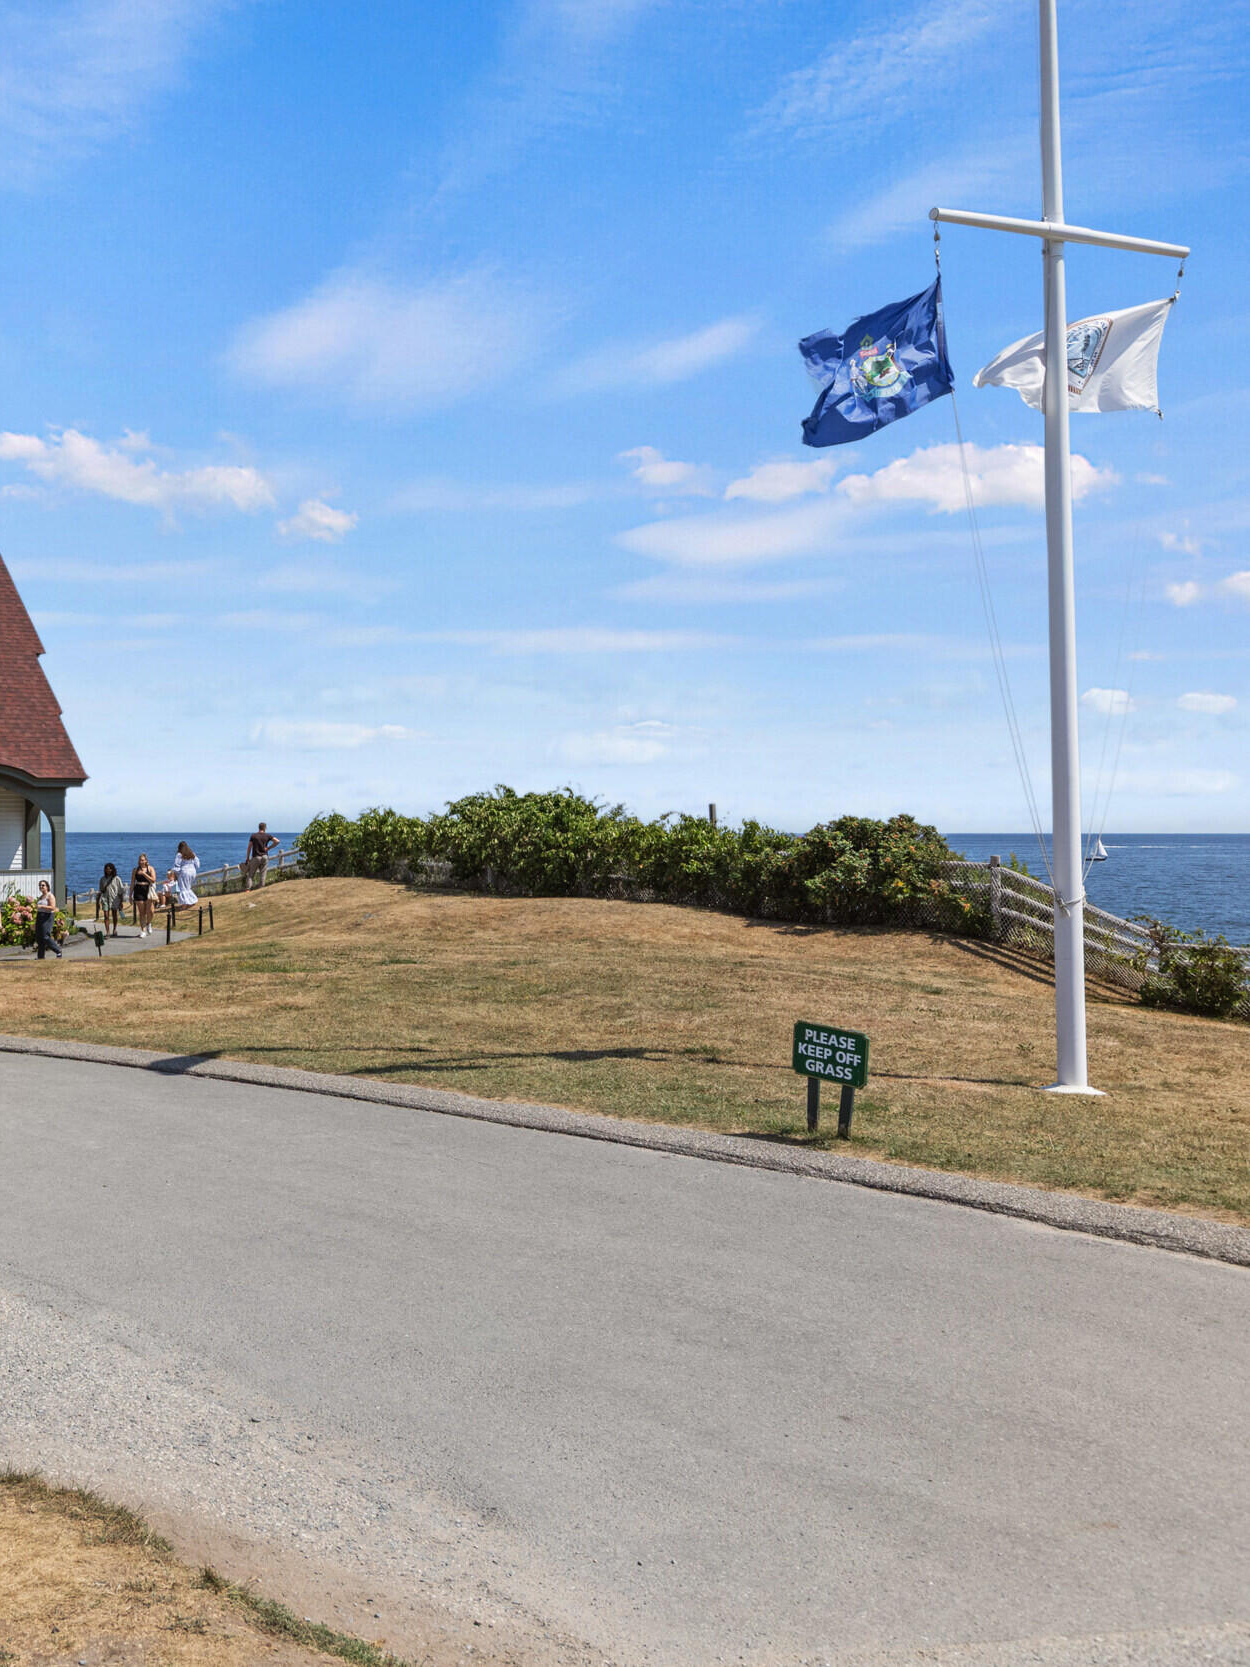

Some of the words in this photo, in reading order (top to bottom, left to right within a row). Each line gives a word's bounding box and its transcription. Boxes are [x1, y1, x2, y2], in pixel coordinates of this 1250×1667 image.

[805, 1028, 856, 1051] PLEASE
[798, 1041, 833, 1060] KEEP
[835, 1051, 862, 1067] OFF
[805, 1059, 853, 1080] GRASS
